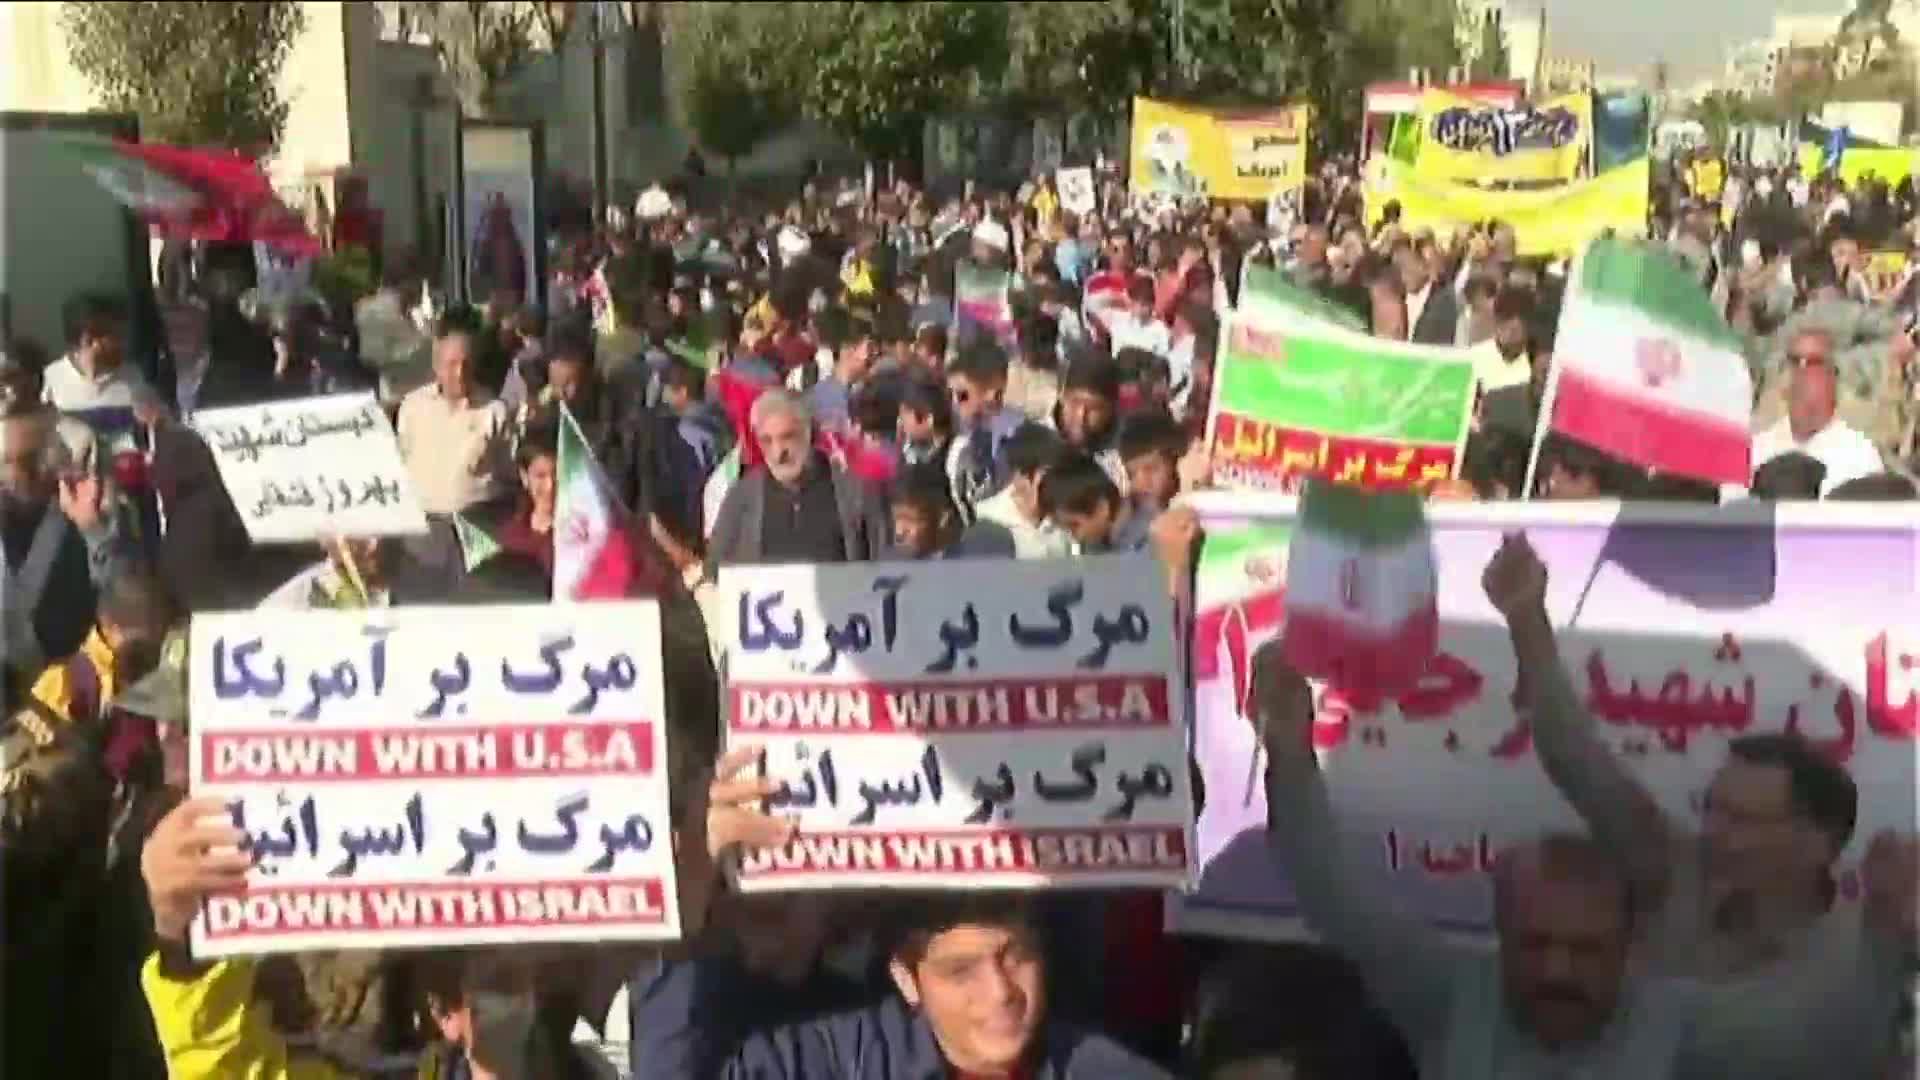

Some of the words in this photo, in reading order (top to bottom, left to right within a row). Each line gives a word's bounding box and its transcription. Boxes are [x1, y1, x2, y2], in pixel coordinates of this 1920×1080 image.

[739, 575, 909, 674] آمریکا
[924, 601, 979, 673] بر
[1009, 580, 1150, 669] مرگ
[212, 624, 398, 721] آمریکا
[415, 652, 471, 719] بر
[500, 634, 637, 715] مرگ
[740, 688, 871, 728] DOWN
[886, 687, 1010, 728] WITH
[1024, 682, 1154, 722] U.S.A
[1586, 631, 1755, 754] شهید
[211, 728, 357, 775] DOWN
[370, 728, 498, 774] WITH
[511, 727, 638, 771] U.S.A
[1033, 743, 1174, 821] مرگ
[964, 761, 1016, 824] بر
[446, 811, 497, 875] بر
[516, 789, 653, 873] مرگ
[741, 834, 885, 872] DOWN
[890, 833, 1019, 870] WITH
[1021, 830, 1185, 869] ISRAEL
[207, 895, 364, 937] DOWN
[370, 886, 499, 930] WITH
[502, 880, 665, 926] ISRAEL
